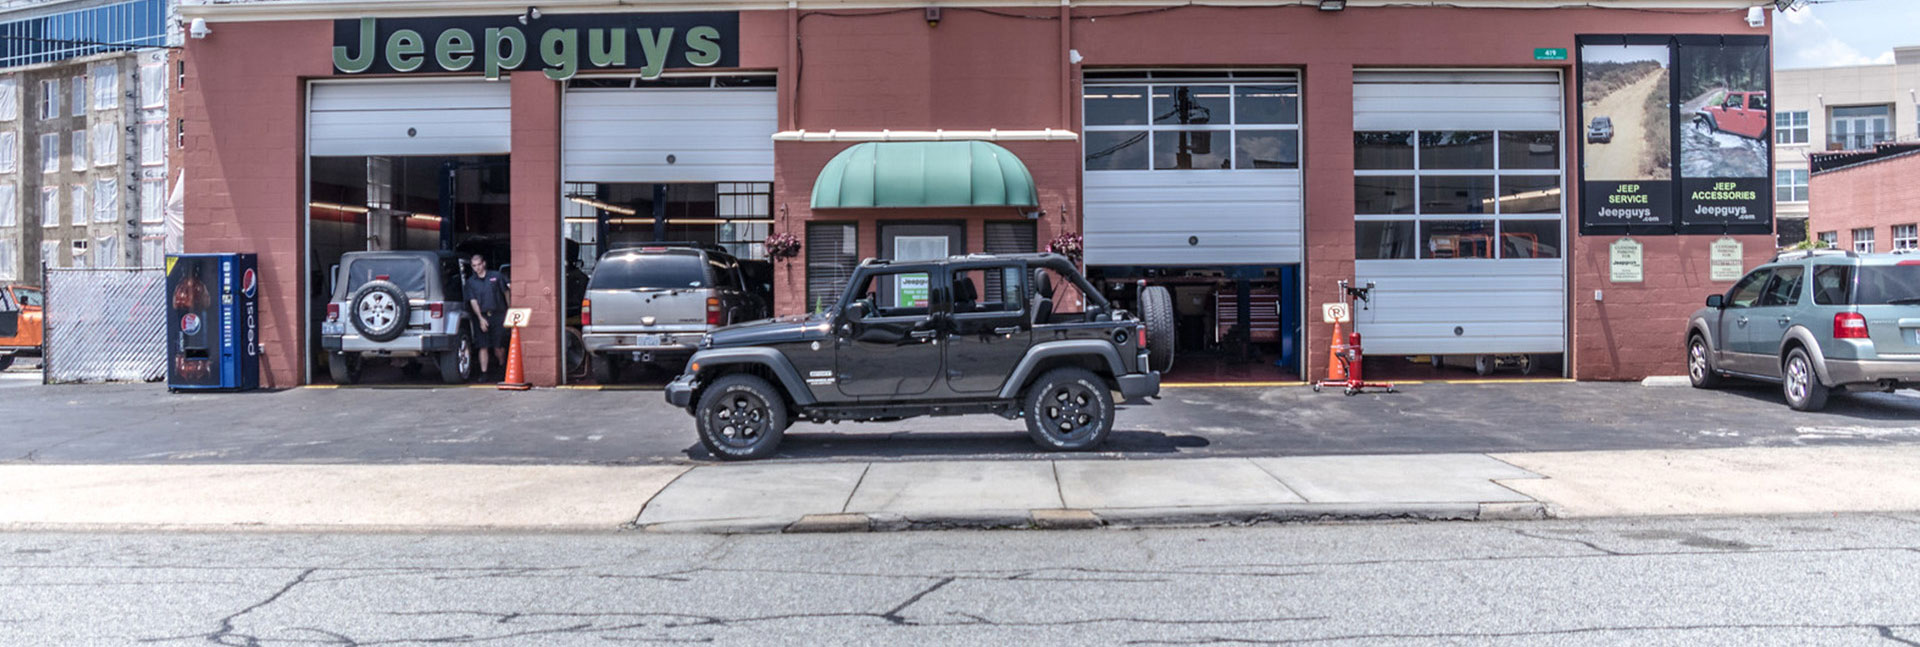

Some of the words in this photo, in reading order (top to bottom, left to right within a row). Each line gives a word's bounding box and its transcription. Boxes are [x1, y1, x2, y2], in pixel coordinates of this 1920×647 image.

[331, 16, 722, 81] Jeepguys
[1616, 184, 1640, 193] JEEP
[1713, 182, 1737, 191] JEEP
[1608, 194, 1648, 204] SERVICE
[1691, 191, 1756, 200] ACCESSORIES
[1598, 206, 1651, 219] Jeepguys
[1694, 204, 1747, 216] Jeepguys
[245, 301, 256, 357] pepsi
